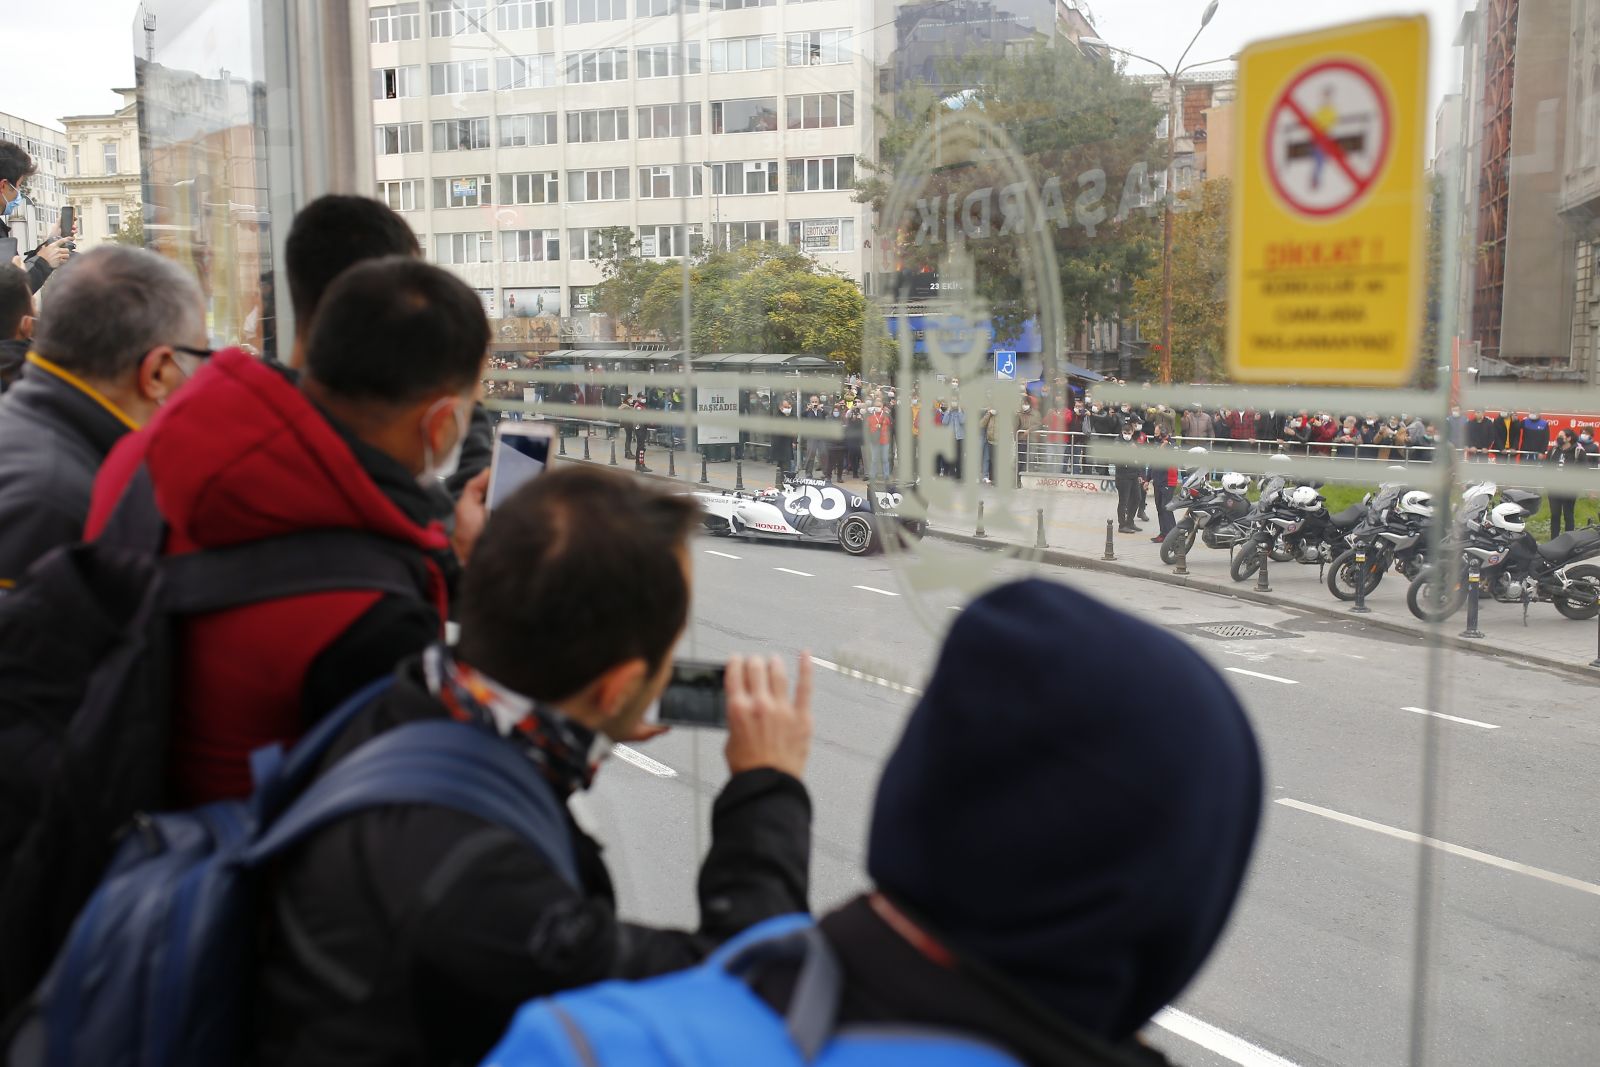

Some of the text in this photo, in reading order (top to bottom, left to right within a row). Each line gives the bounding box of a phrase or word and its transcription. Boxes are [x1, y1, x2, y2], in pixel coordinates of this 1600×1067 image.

[824, 225, 838, 235] SHOP
[930, 282, 940, 290] 23
[580, 295, 587, 303] S
[711, 394, 725, 404] BİR
[785, 477, 826, 486] ALPHATAURI
[850, 495, 862, 508] 10
[755, 522, 788, 531] HONDA
